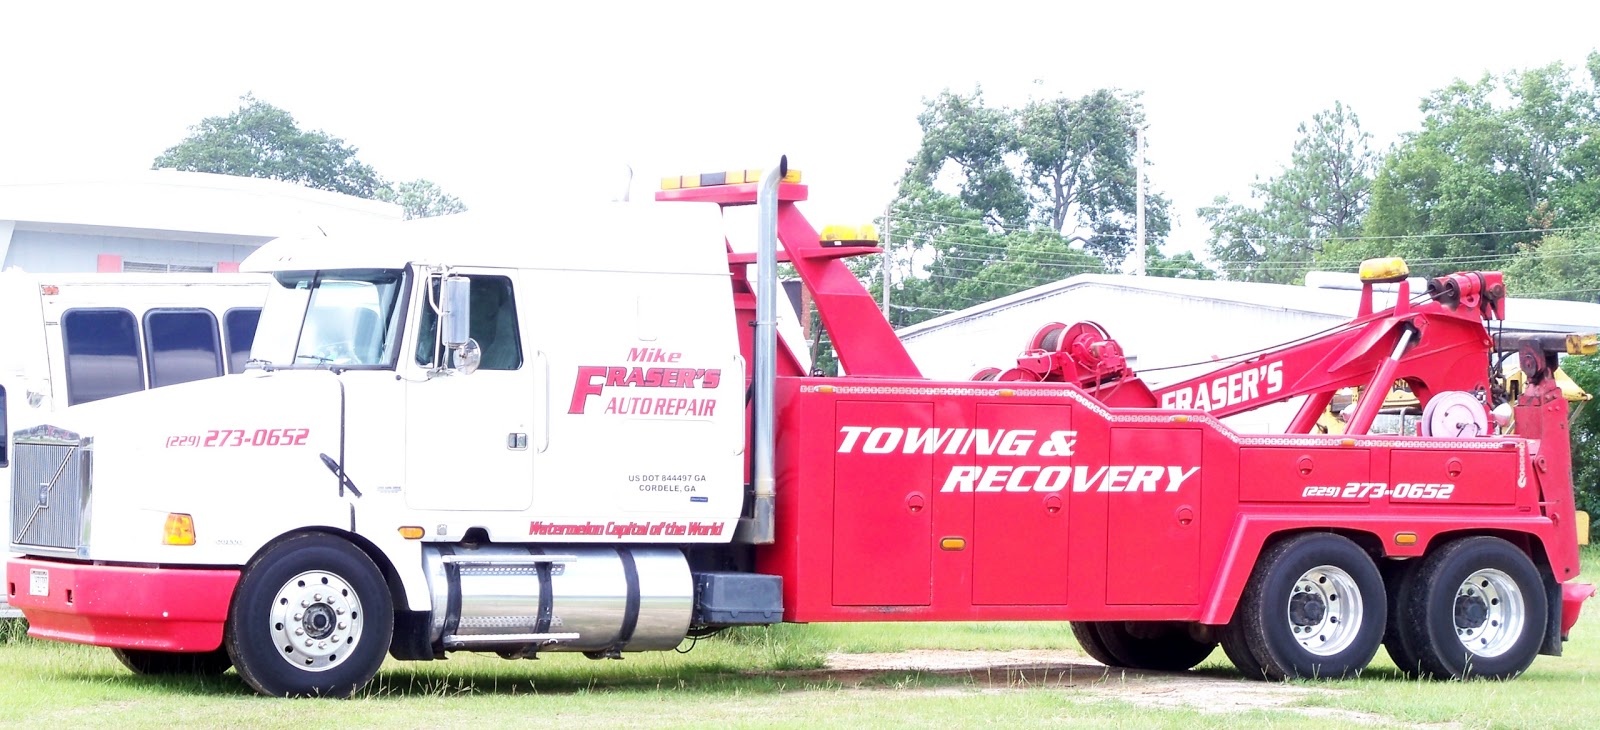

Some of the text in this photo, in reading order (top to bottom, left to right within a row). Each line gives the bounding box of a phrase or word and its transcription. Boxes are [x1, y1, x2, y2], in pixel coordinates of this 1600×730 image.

[626, 347, 682, 363] Mike
[567, 365, 722, 415] FRASER'S
[1162, 360, 1283, 412] FRASER'S
[604, 397, 717, 417] AUTO REPAIR
[165, 428, 310, 448] (229) 273-0652
[836, 426, 1078, 457] TOWING &
[639, 484, 682, 493] CORDELE,
[940, 465, 1201, 492] RECOVERY
[1302, 482, 1455, 499] (229) 273-0652
[529, 521, 725, 539] Watermelon Capital of the World
